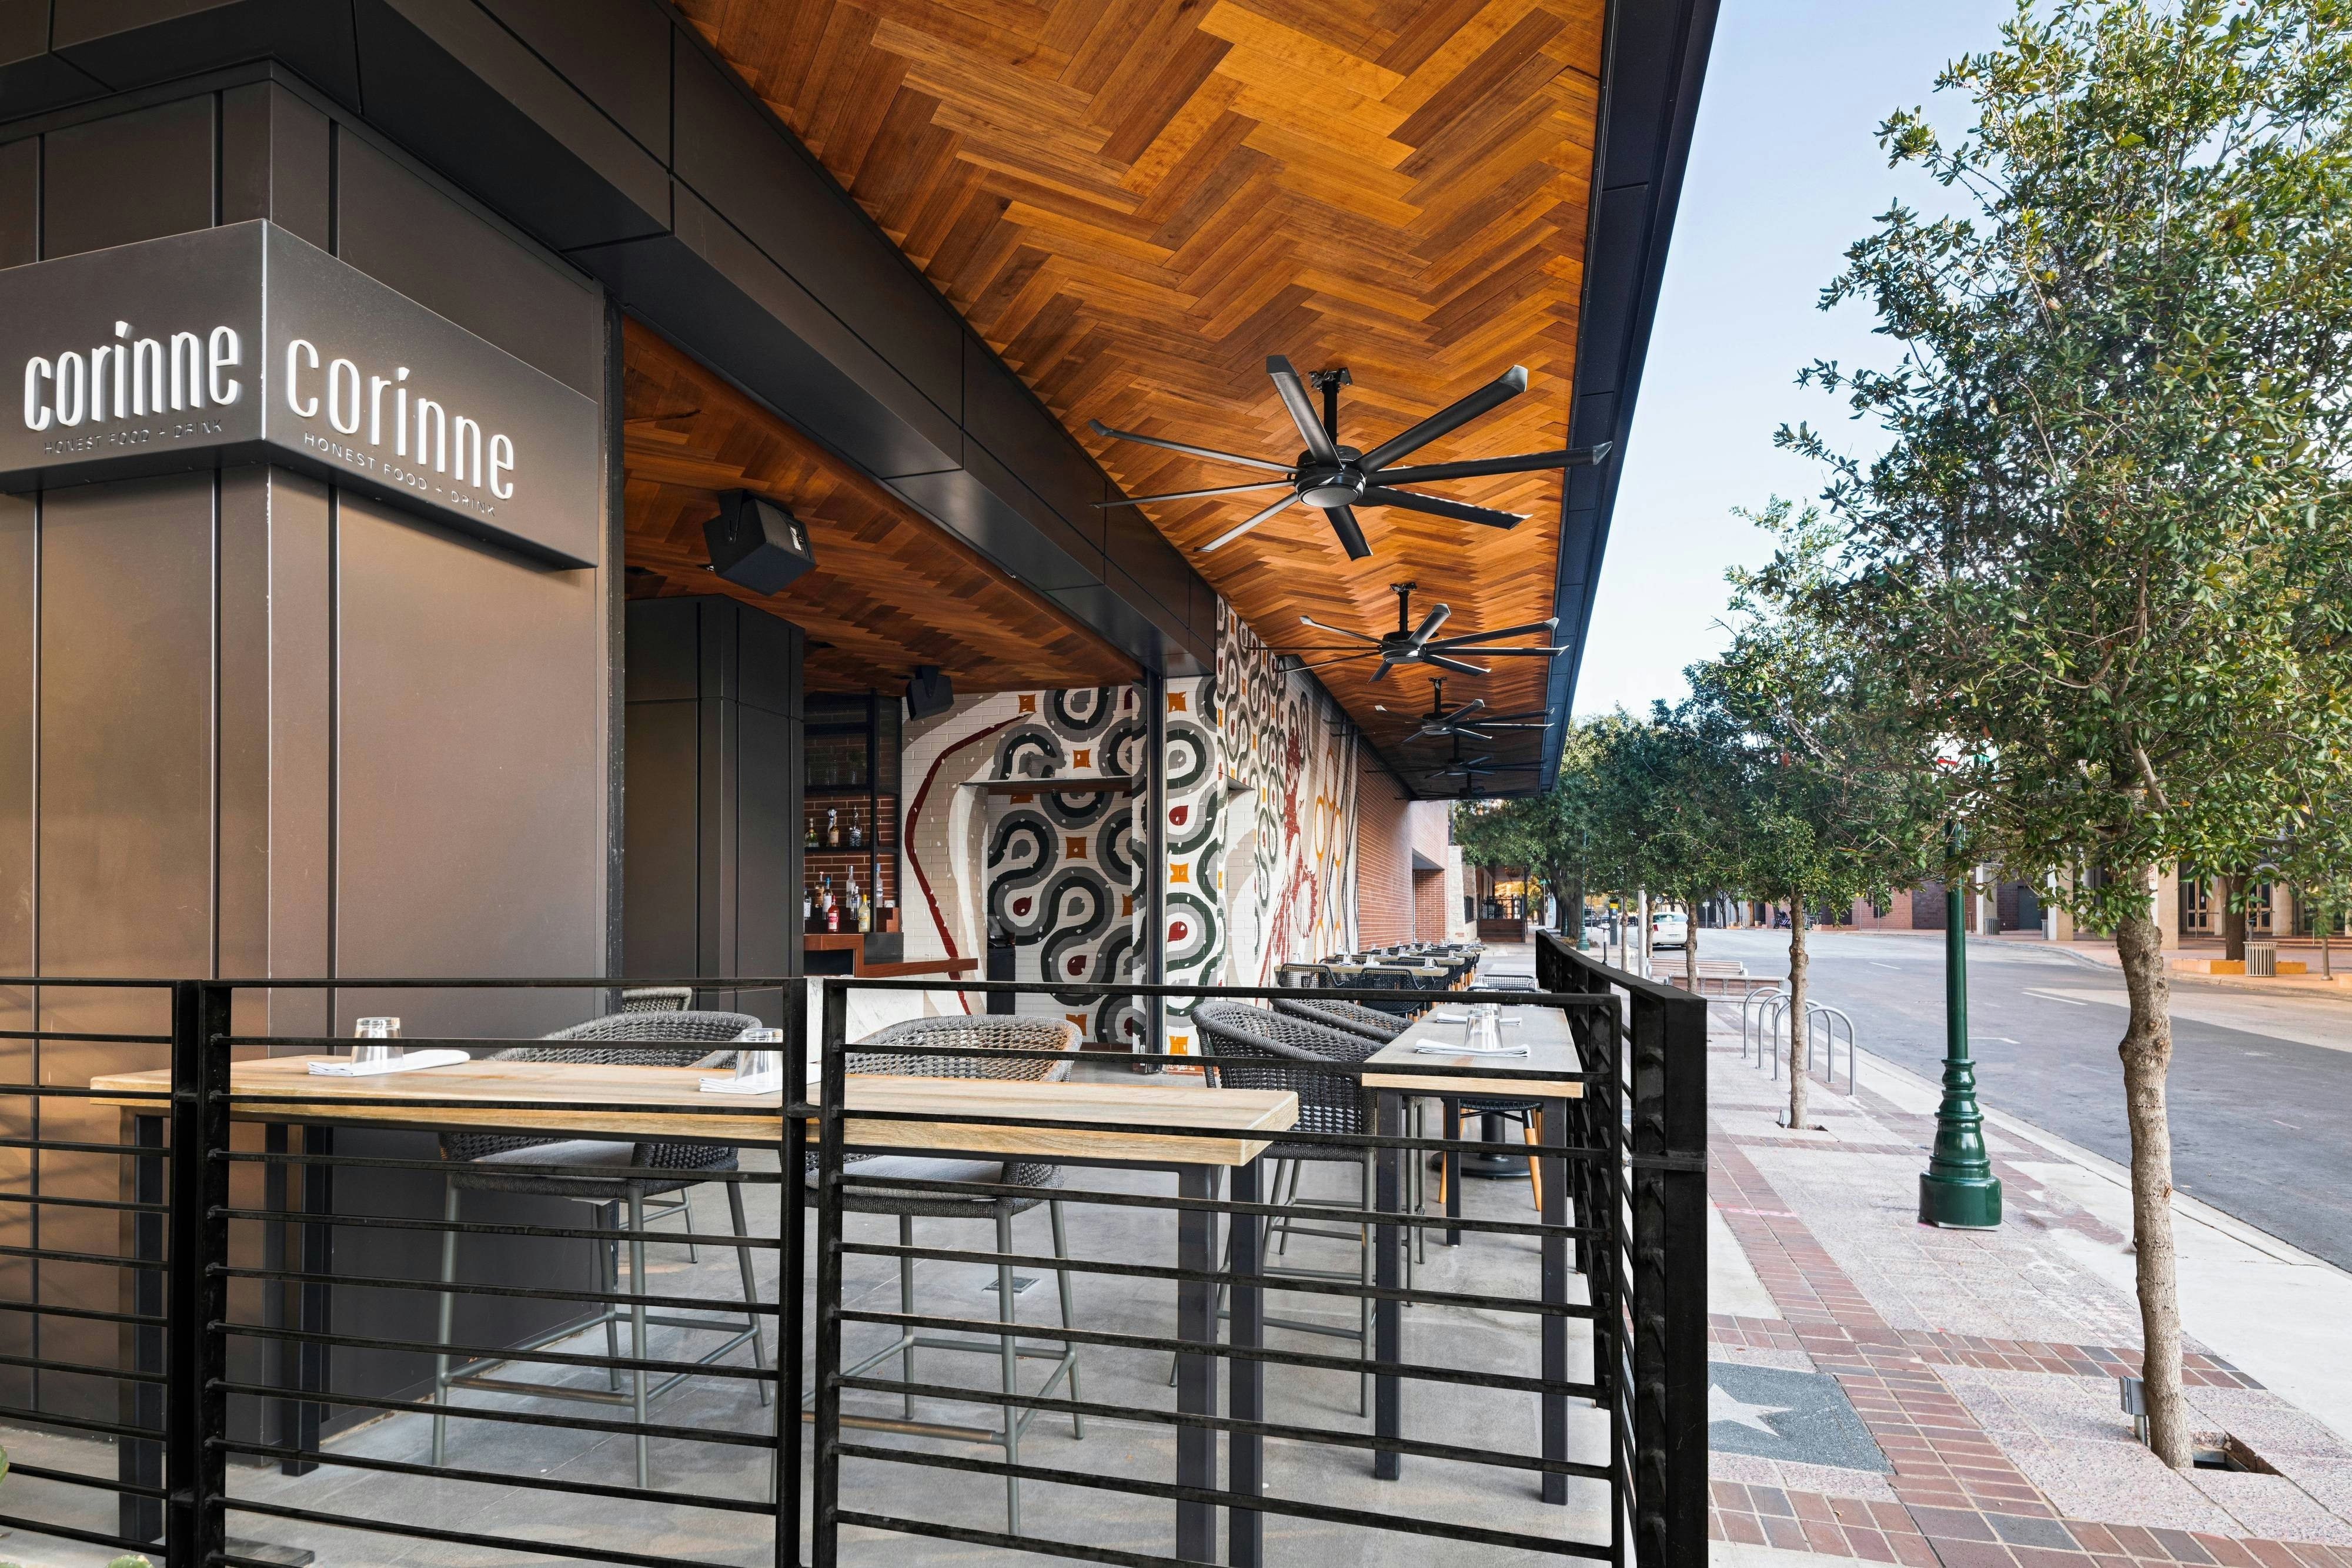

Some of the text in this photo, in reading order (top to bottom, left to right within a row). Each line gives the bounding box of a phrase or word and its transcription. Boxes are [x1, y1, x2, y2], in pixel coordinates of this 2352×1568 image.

[24, 320, 239, 432] corinne
[287, 339, 514, 500] corinne
[44, 419, 223, 454] HONEST FOOD + DRINK
[304, 431, 496, 517] HONEST FOOD + DRINK
